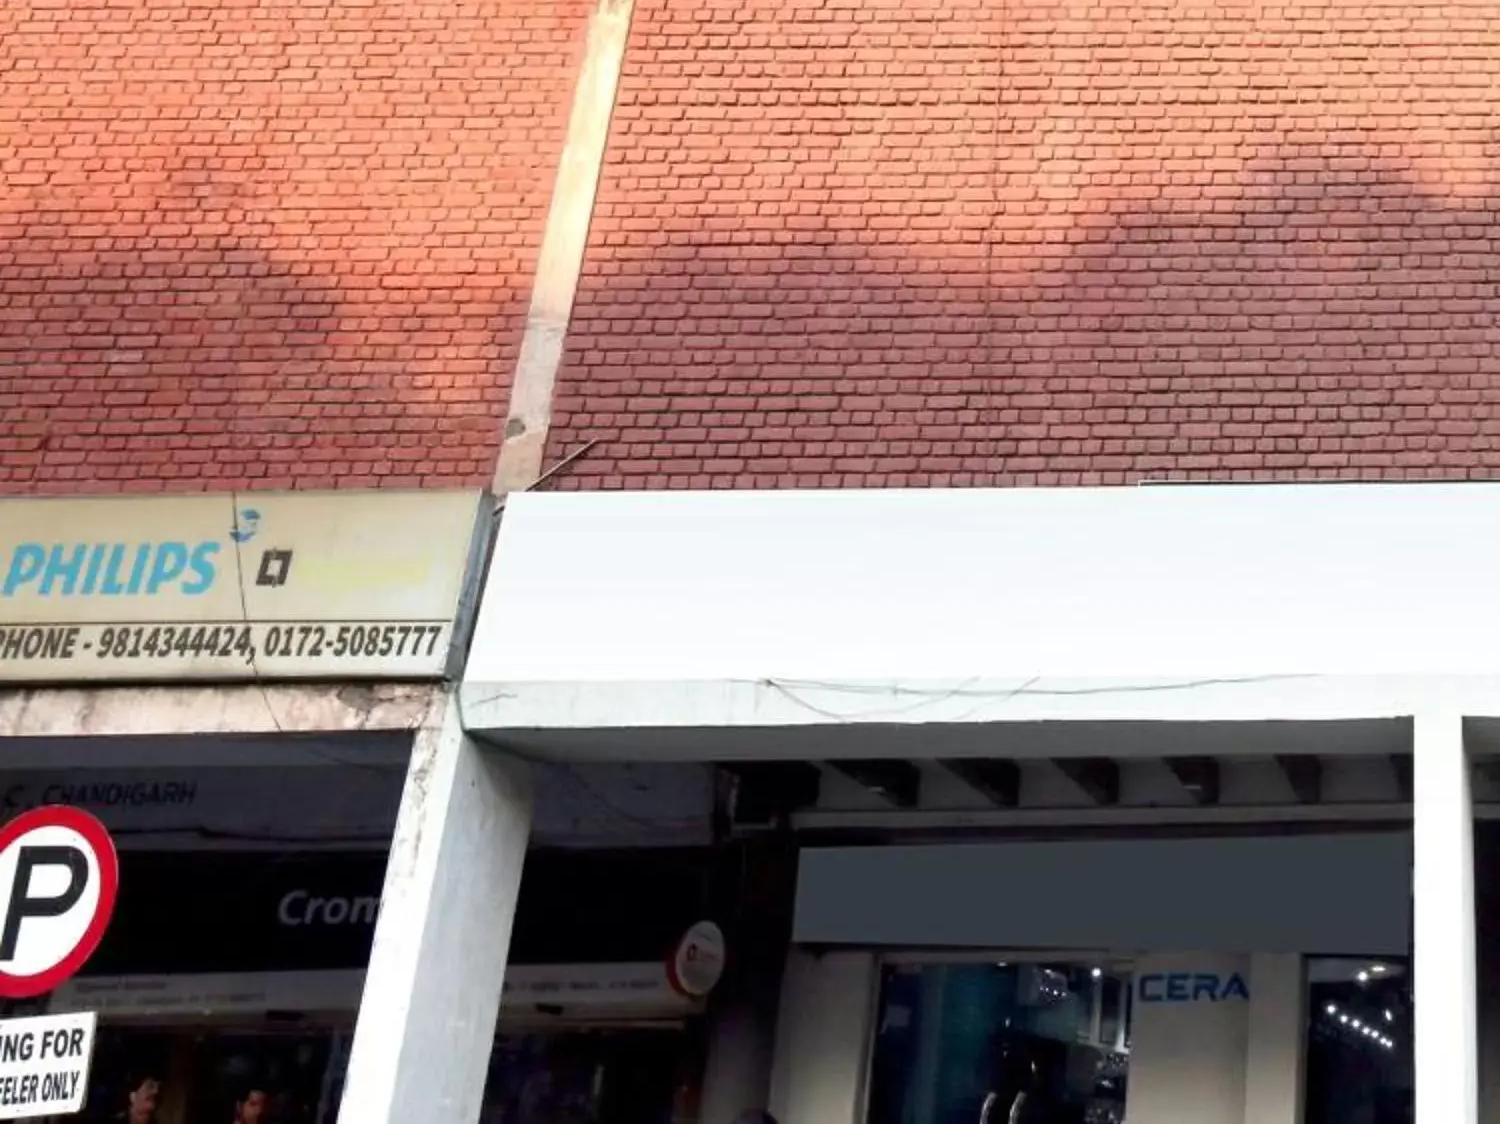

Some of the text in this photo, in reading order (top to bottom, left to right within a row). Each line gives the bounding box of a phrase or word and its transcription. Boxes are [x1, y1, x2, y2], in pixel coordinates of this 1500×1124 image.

[2, 543, 221, 595] PHILIPS
[96, 626, 256, 664] 9814344424,
[264, 625, 441, 658] 0172-5085777
[42, 781, 197, 806] CHANDIGARH
[0, 846, 89, 961] P
[1139, 973, 1249, 1001] CERA
[40, 1027, 85, 1059] FOR
[41, 1070, 81, 1102] ONLY
